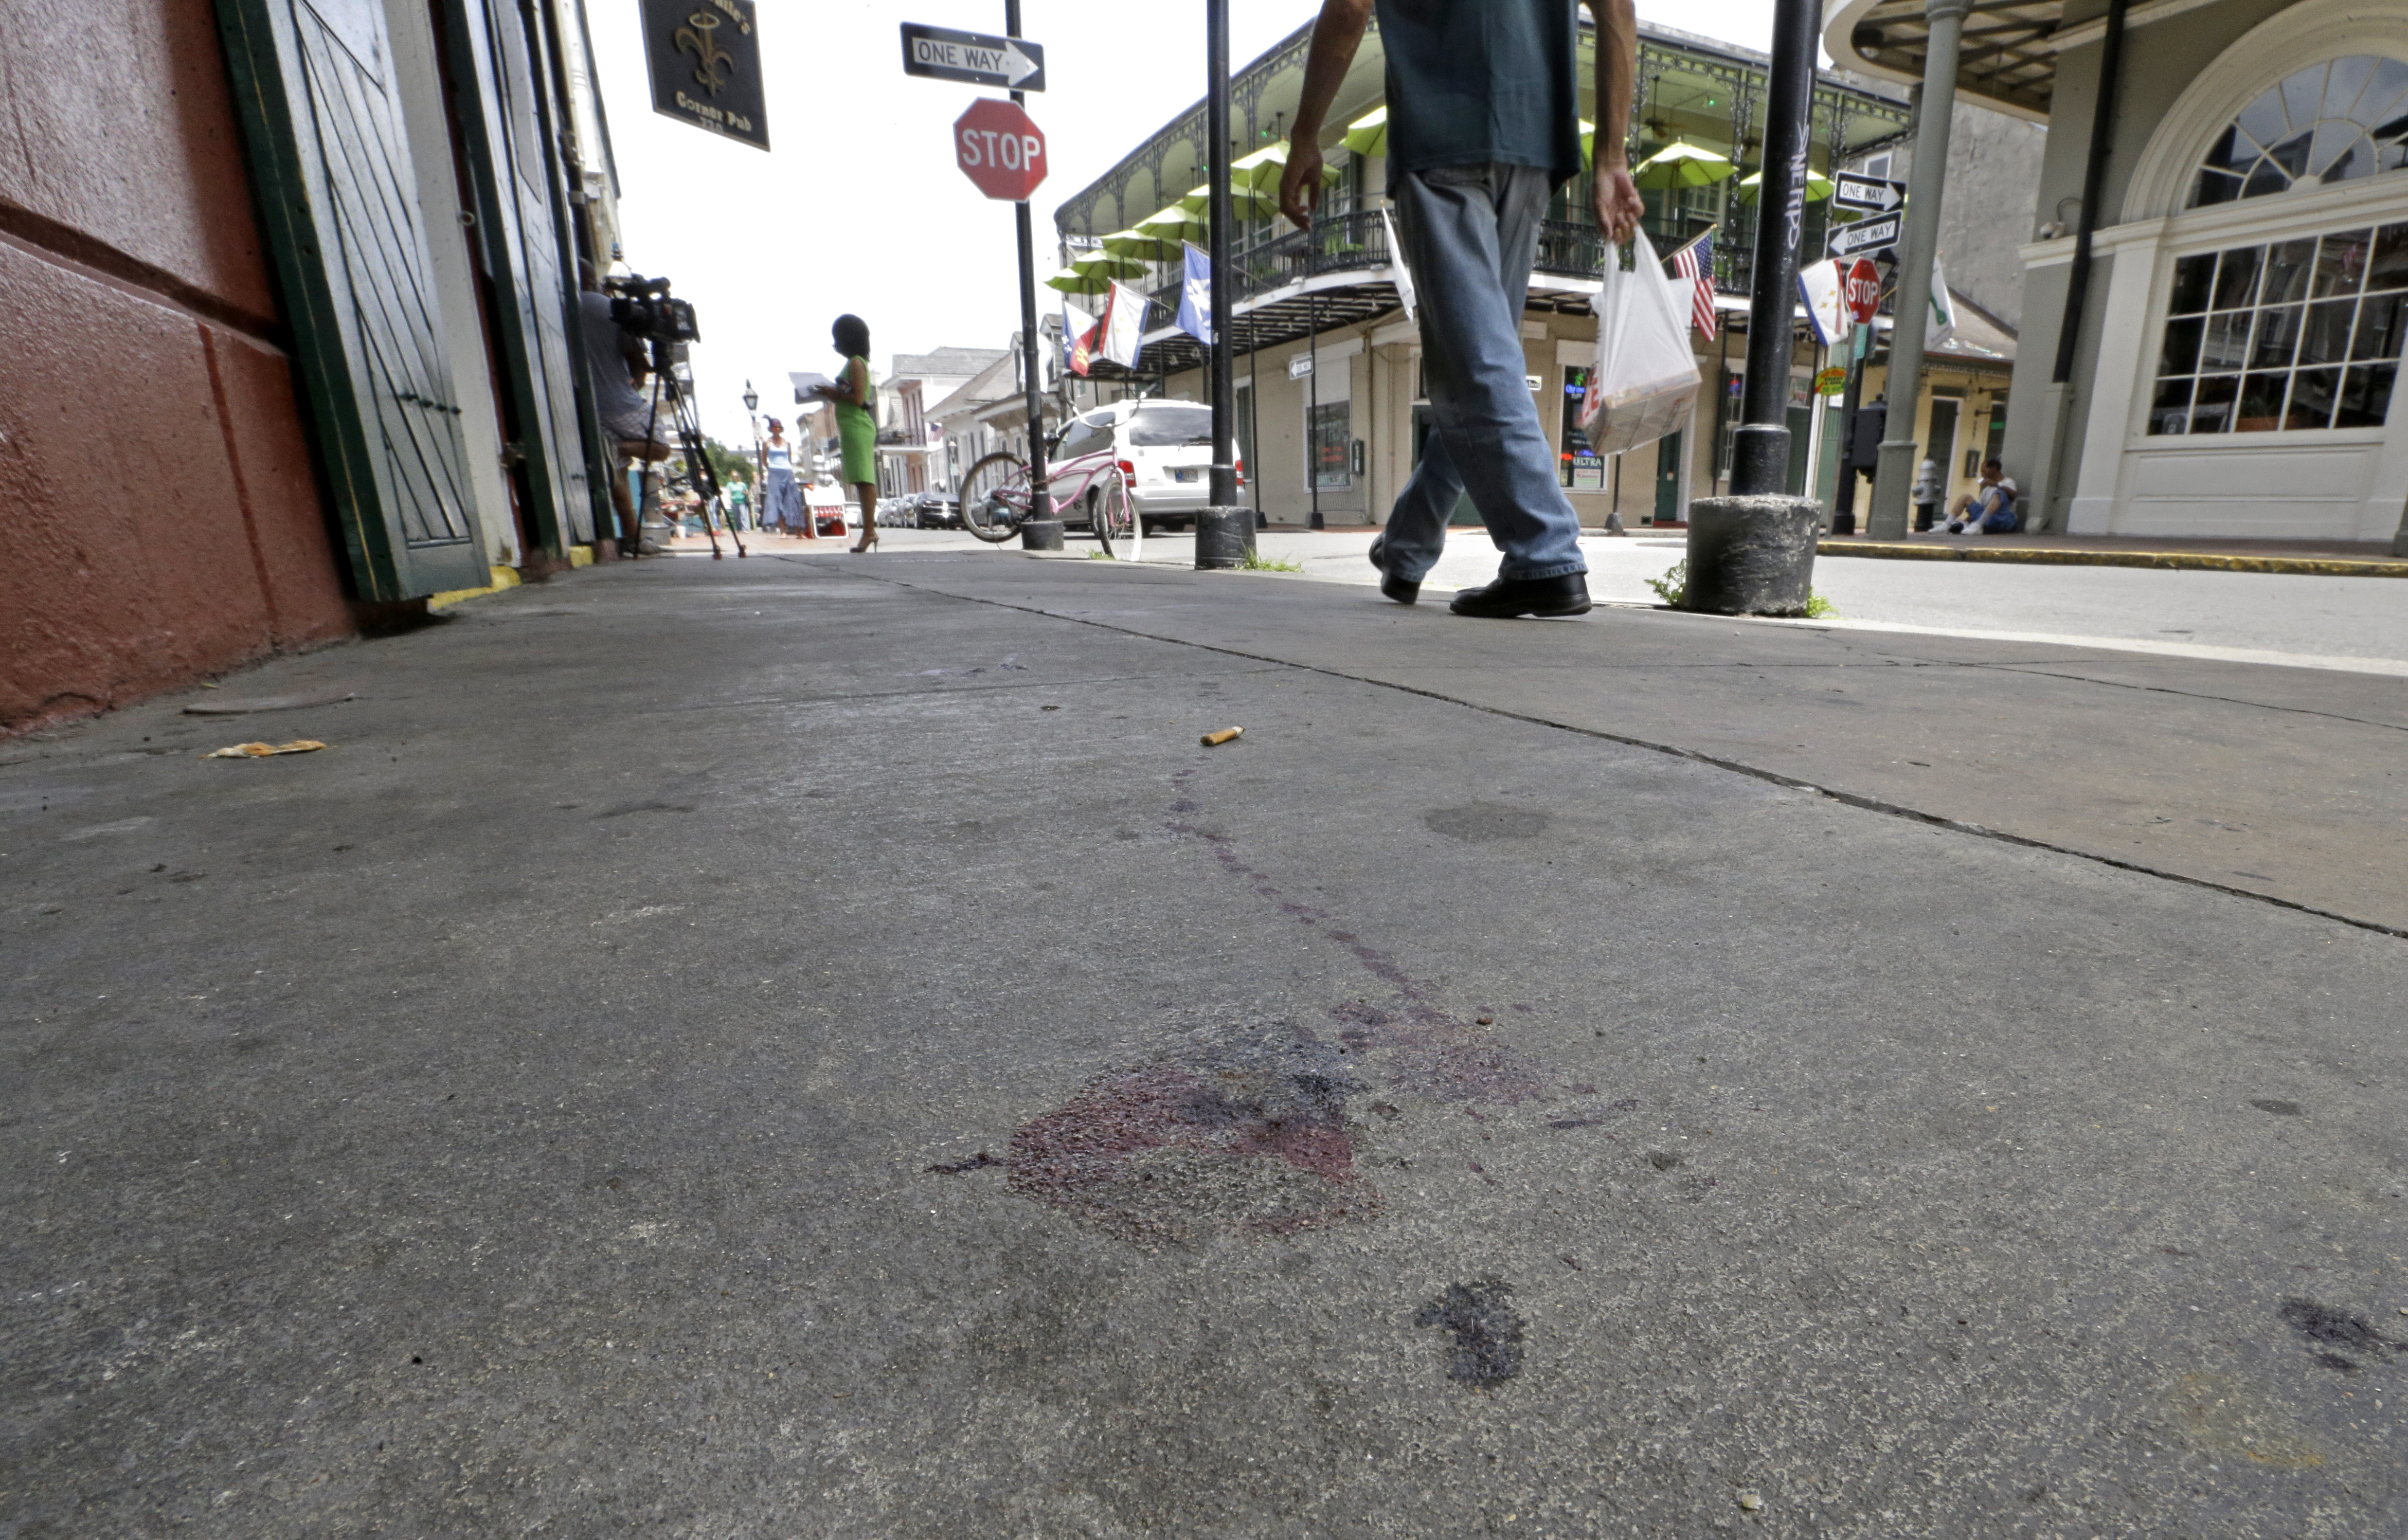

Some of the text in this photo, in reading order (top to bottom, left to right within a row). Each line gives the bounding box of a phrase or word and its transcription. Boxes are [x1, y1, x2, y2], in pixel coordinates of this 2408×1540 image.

[919, 42, 1002, 72] ONE WAY
[676, 91, 752, 132] Corner Pub
[962, 129, 1041, 171] STOP
[1843, 183, 1884, 202] ONE WAY
[1847, 223, 1892, 245] ONE WAY
[1848, 278, 1877, 304] STOP
[1573, 457, 1602, 466] ULTRA
